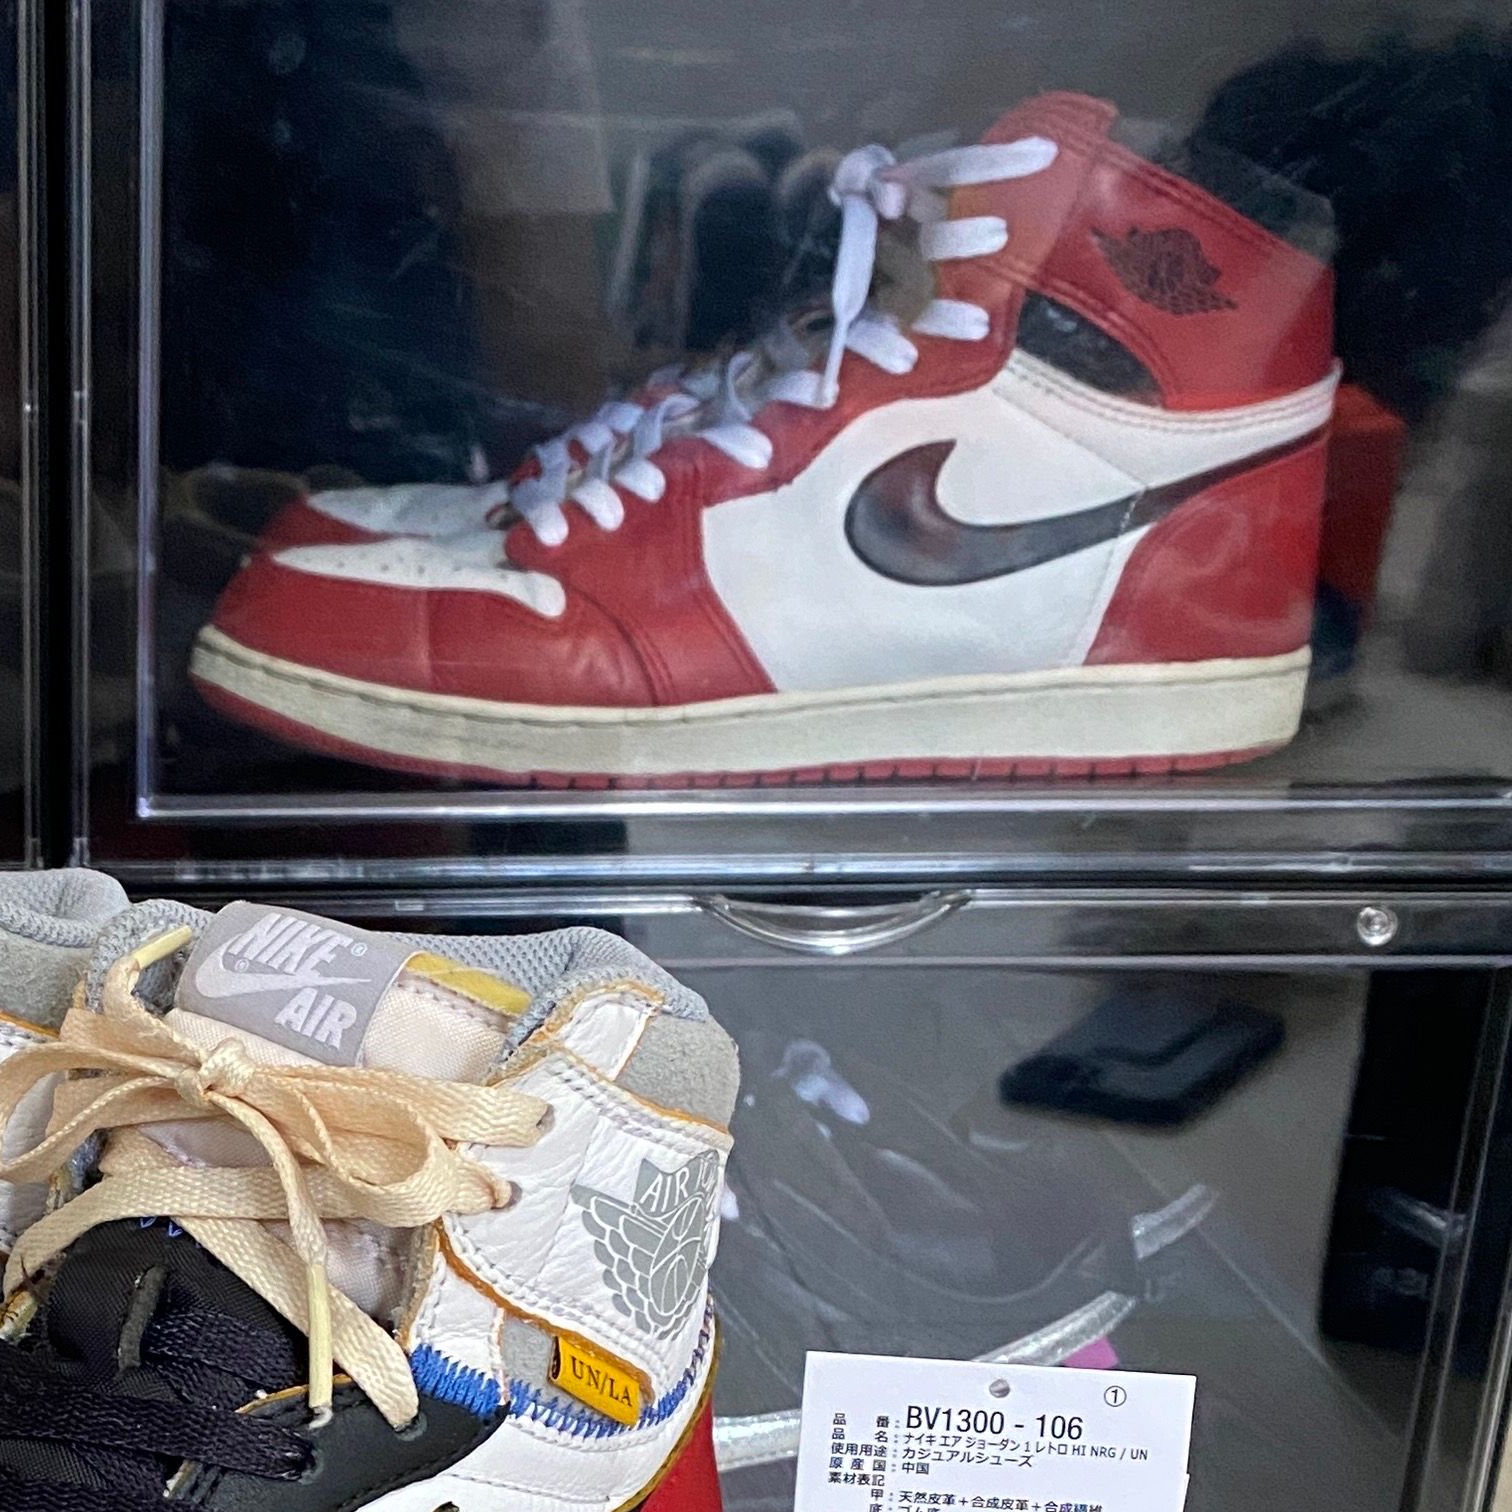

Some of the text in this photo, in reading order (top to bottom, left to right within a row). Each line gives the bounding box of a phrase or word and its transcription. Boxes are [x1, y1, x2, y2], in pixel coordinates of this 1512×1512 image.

[273, 986, 358, 1051] AIR
[639, 1166, 691, 1213] AIR
[569, 1355, 633, 1408] UN/LA
[905, 1404, 1006, 1436] BV1300
[1035, 1413, 1085, 1441] 106
[1071, 1444, 1087, 1457] HI
[1090, 1445, 1117, 1459] NRG
[1130, 1448, 1149, 1461] UN
